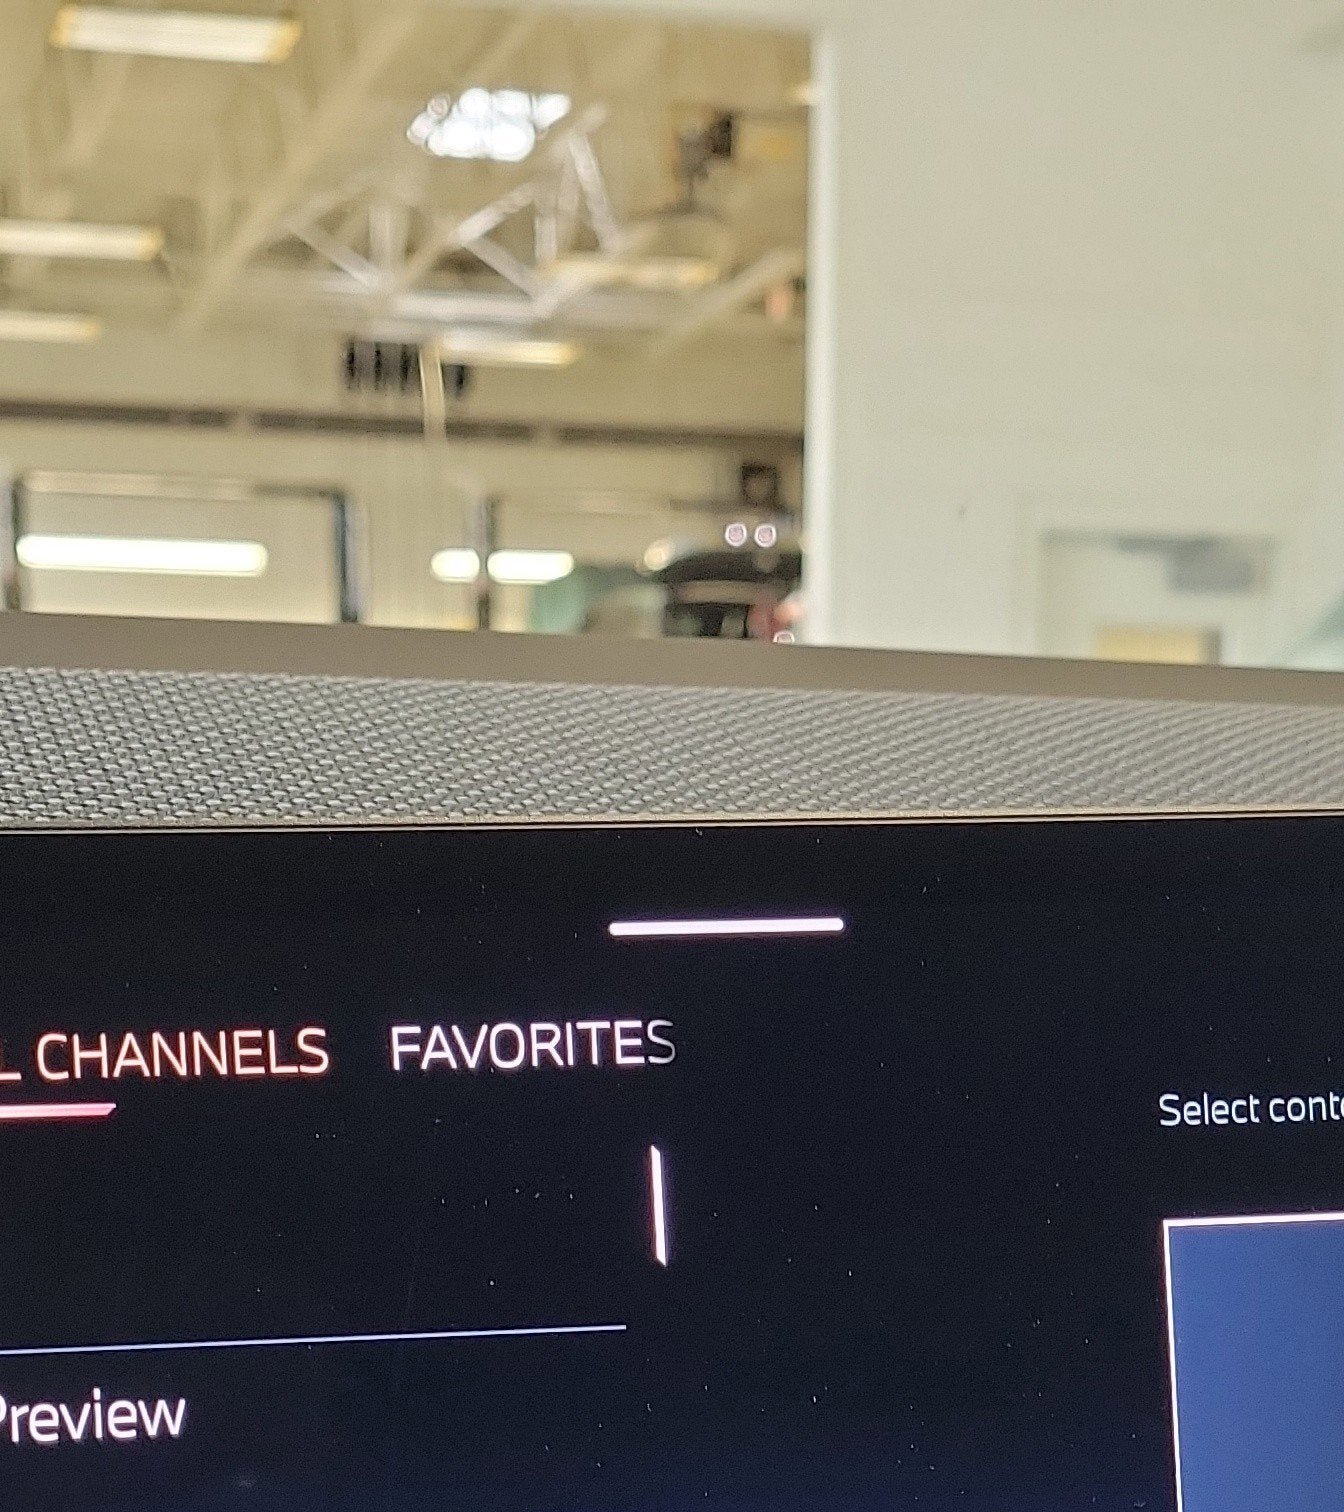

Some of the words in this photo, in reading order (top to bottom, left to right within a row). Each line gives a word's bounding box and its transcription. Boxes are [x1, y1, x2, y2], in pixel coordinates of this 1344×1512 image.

[36, 1027, 330, 1081] CHANNELS
[390, 1019, 676, 1071] FAVORITES
[1159, 1091, 1260, 1127] Select
